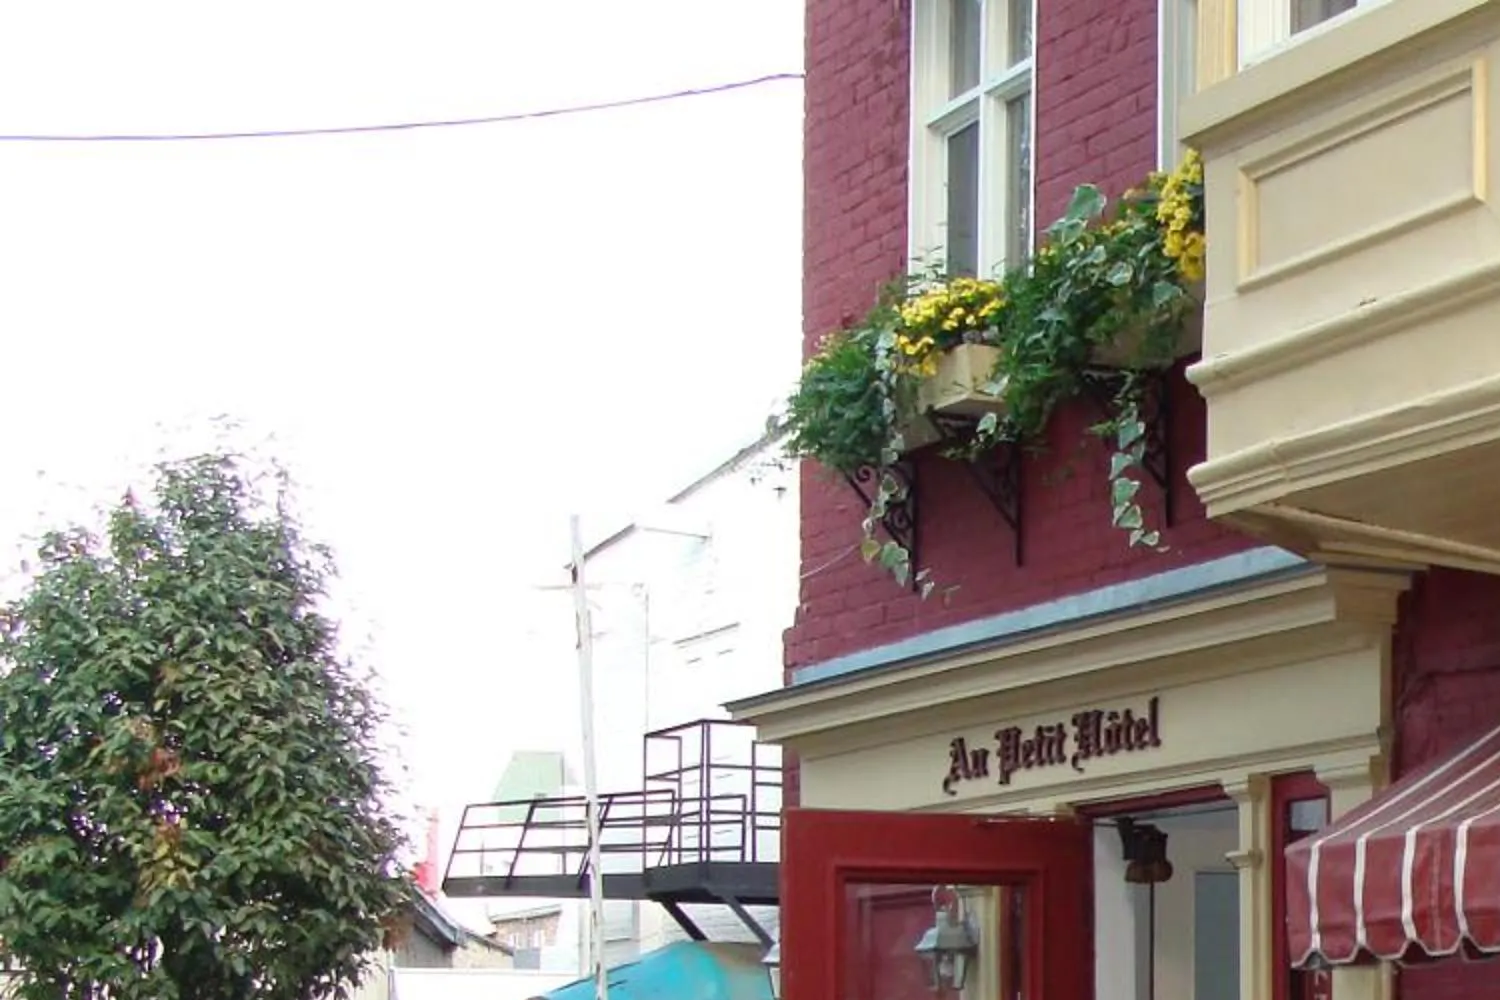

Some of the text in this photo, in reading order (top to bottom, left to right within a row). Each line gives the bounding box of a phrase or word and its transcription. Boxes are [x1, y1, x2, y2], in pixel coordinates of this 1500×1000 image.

[943, 696, 1162, 795] Au Petit Hôtel
